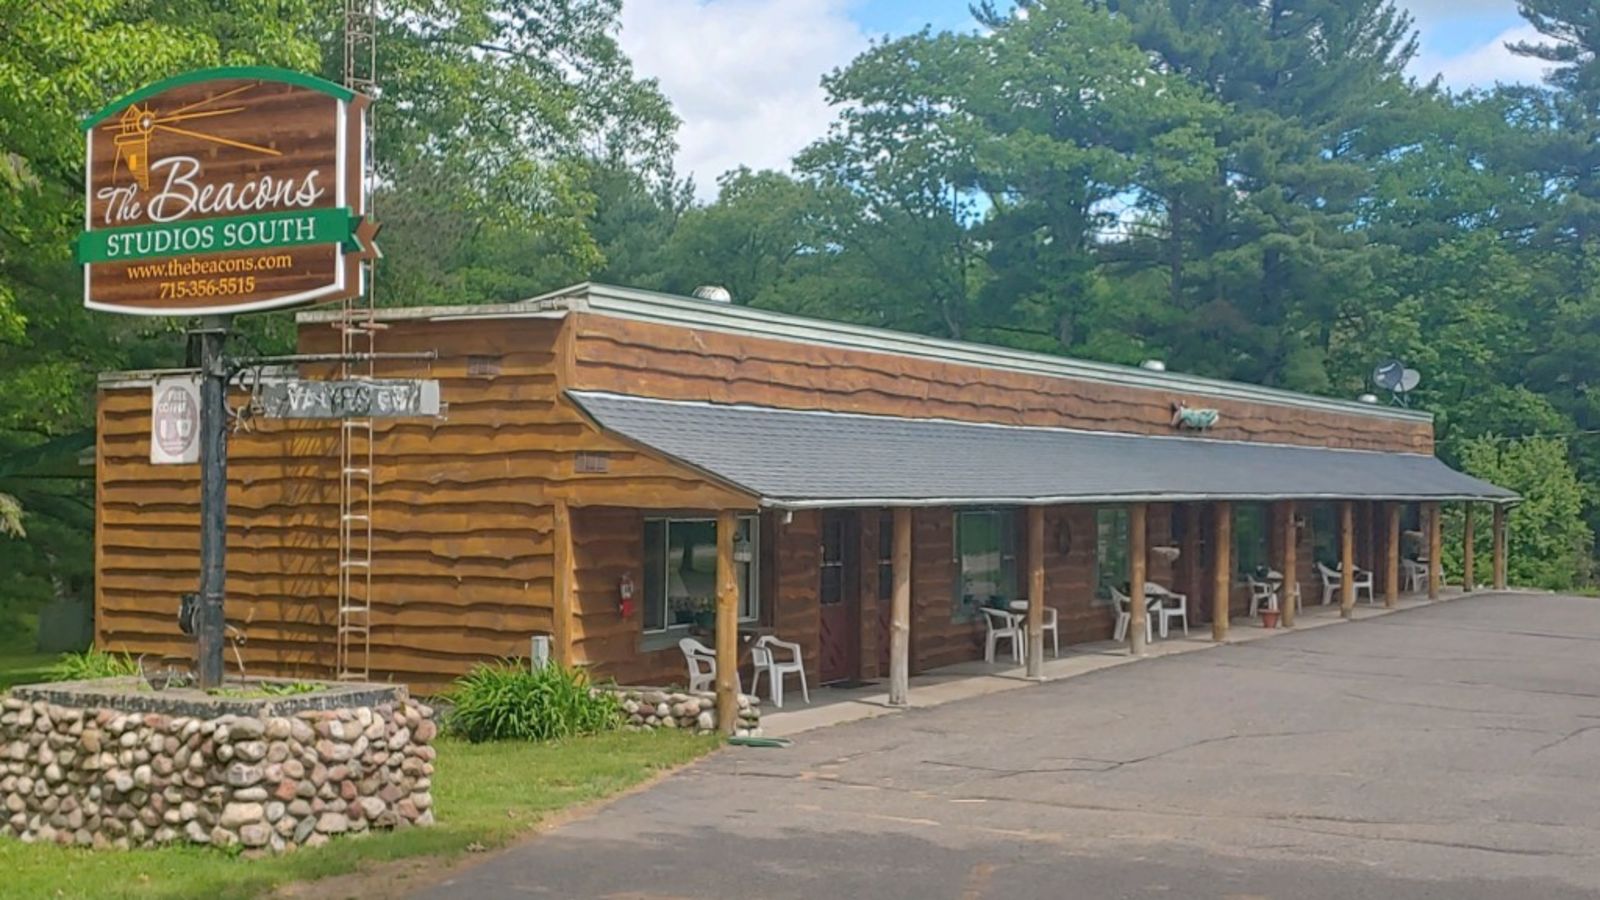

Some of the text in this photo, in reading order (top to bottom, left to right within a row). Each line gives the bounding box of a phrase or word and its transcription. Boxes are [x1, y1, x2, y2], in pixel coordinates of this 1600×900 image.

[98, 156, 325, 224] The Beacons
[106, 217, 316, 257] STUDIOS SOUTH
[127, 254, 292, 280] www.thebeacons.com
[159, 276, 255, 299] 715-356-5515
